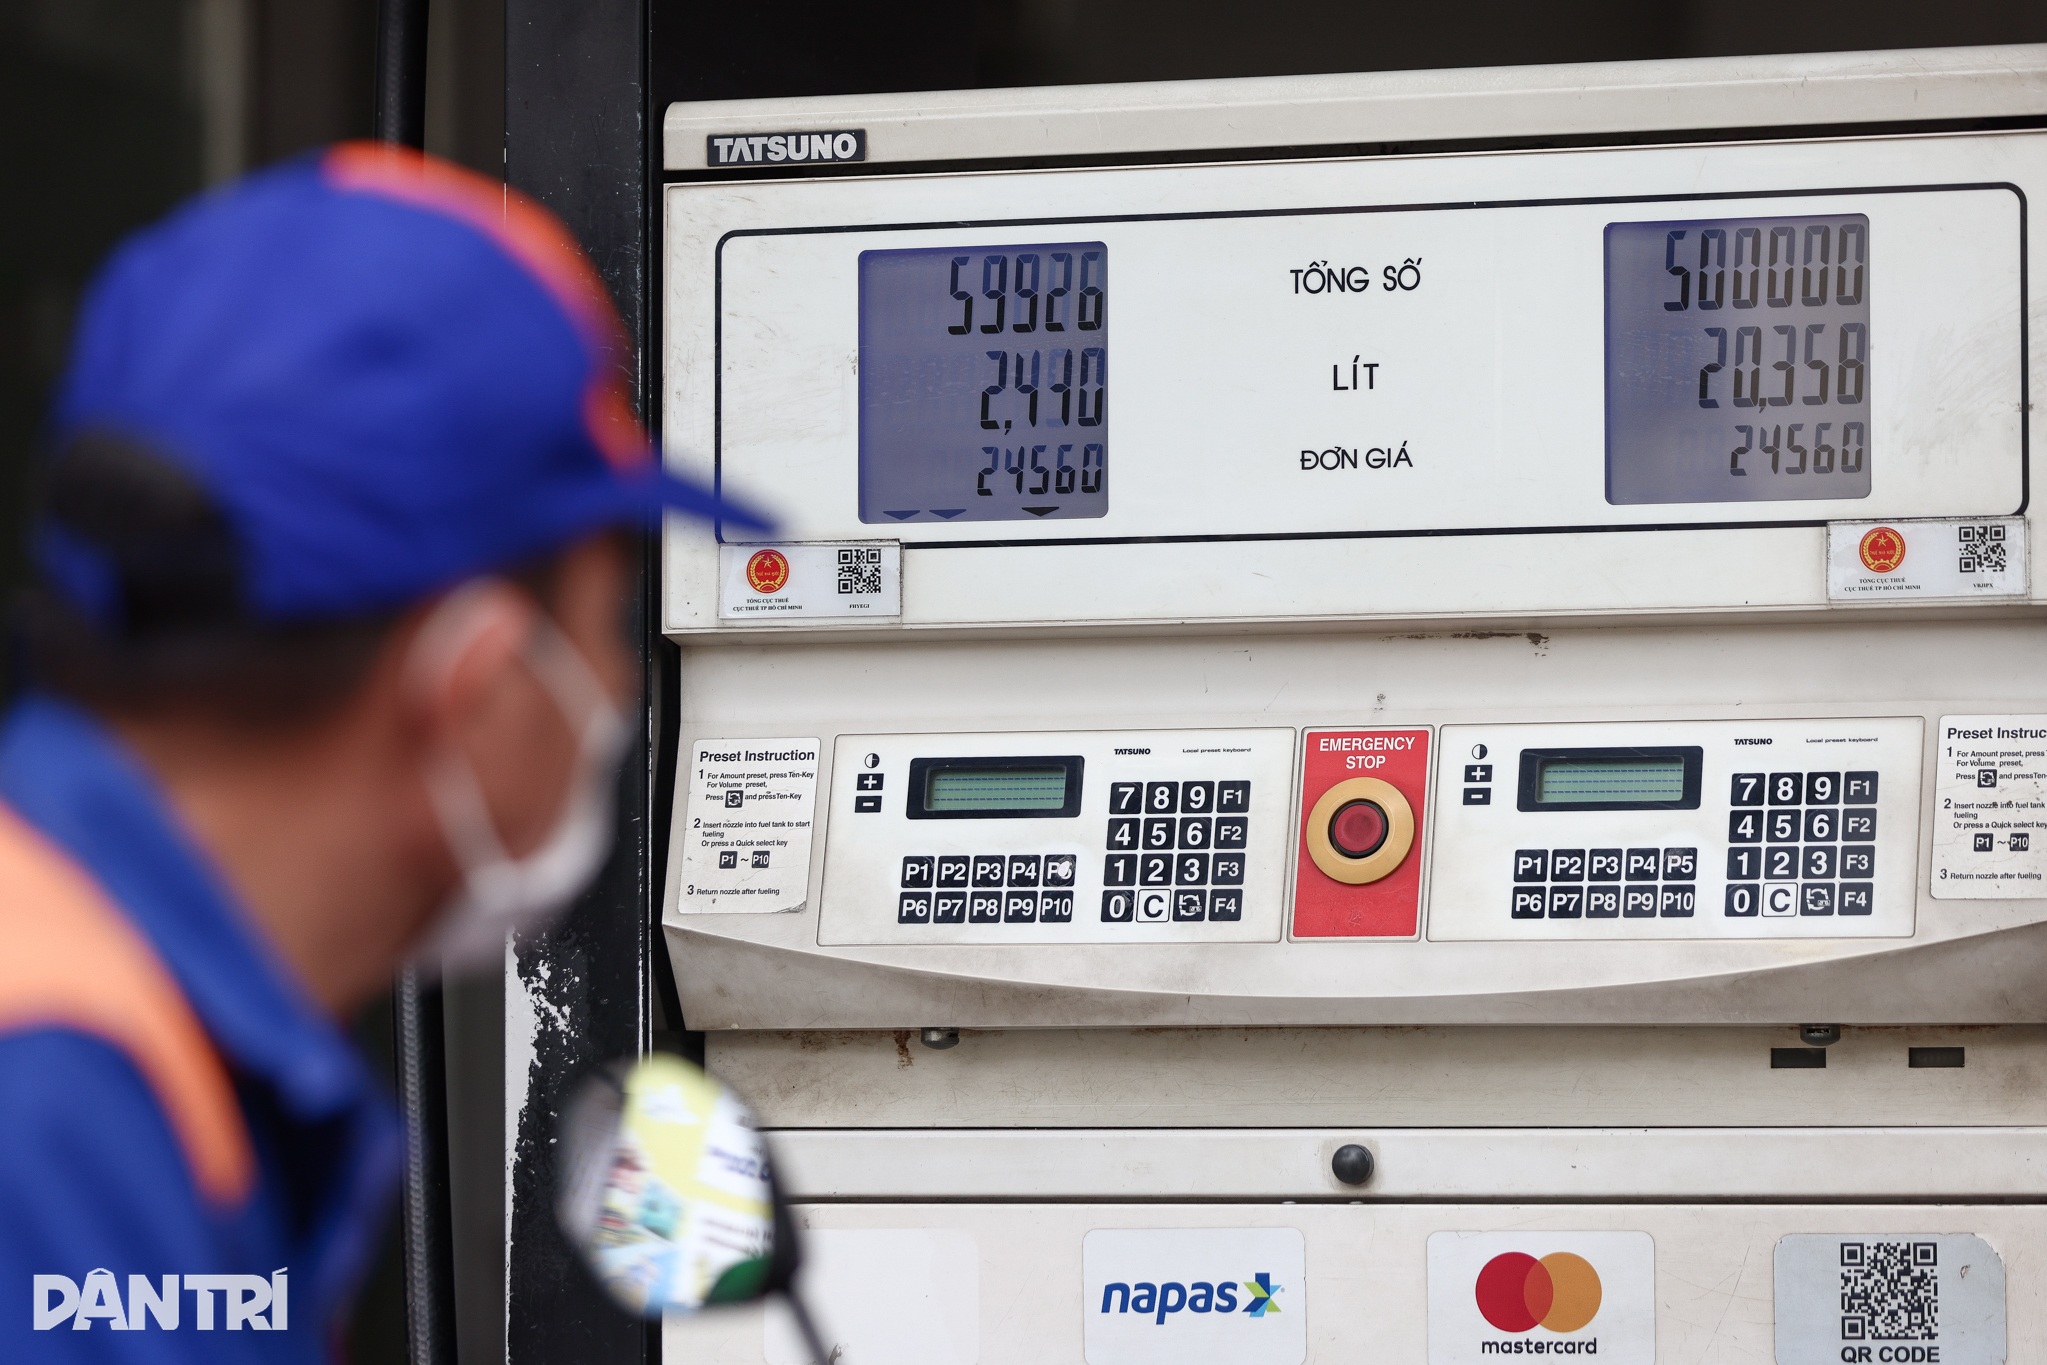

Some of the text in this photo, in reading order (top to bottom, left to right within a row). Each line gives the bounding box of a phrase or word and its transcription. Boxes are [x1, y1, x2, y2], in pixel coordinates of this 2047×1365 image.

[713, 133, 858, 163] TATSUNO
[1290, 258, 1422, 294] TỔNG SỐ
[1664, 224, 1865, 311] 500000
[948, 251, 1104, 336] 59926
[1333, 355, 1379, 390] LÍT
[1699, 322, 1866, 413] 20,358
[1300, 440, 1413, 470] ĐƠN GIÁ
[1730, 421, 1864, 476] 24560
[977, 444, 1103, 496] 24560
[1947, 727, 2047, 739] Preset Instruc
[1319, 736, 1415, 752] EMERGENCY
[1947, 746, 1952, 757] 1
[700, 750, 815, 762] Preset Instruction
[1346, 755, 1386, 769] STOP
[699, 769, 704, 779] 1
[789, 771, 814, 779] Ten-Key
[1118, 786, 1242, 809] 7 8 9 F1
[1740, 777, 1870, 801] 7 8 9 F1
[1944, 798, 1951, 809] 2
[694, 818, 700, 828] 2
[1737, 814, 1870, 839] 4 5 6 F2
[1115, 823, 1242, 846] 4 5 6 F2
[1976, 837, 2028, 848] P1 P10
[721, 855, 768, 865] P1 P10
[1114, 858, 1239, 882] 1 2 3 F3
[1519, 856, 1693, 875] P1 P2 P3 P4 P5
[1737, 851, 1868, 875] 1 2 3 F3
[905, 862, 1037, 881] P1 P2 P3 P4
[1940, 869, 1947, 879] 3
[687, 885, 694, 895] 3
[1733, 888, 1866, 913] 0 C F4
[902, 898, 1071, 917] P6 P7 P8 P9 P10
[1110, 895, 1236, 918] 0 C F4
[1516, 892, 1693, 912] P6 P7 P8 P9 P10
[1101, 1282, 1238, 1325] napas
[1482, 1337, 1597, 1354] mastercard
[1841, 1346, 1940, 1364] QR CODE
